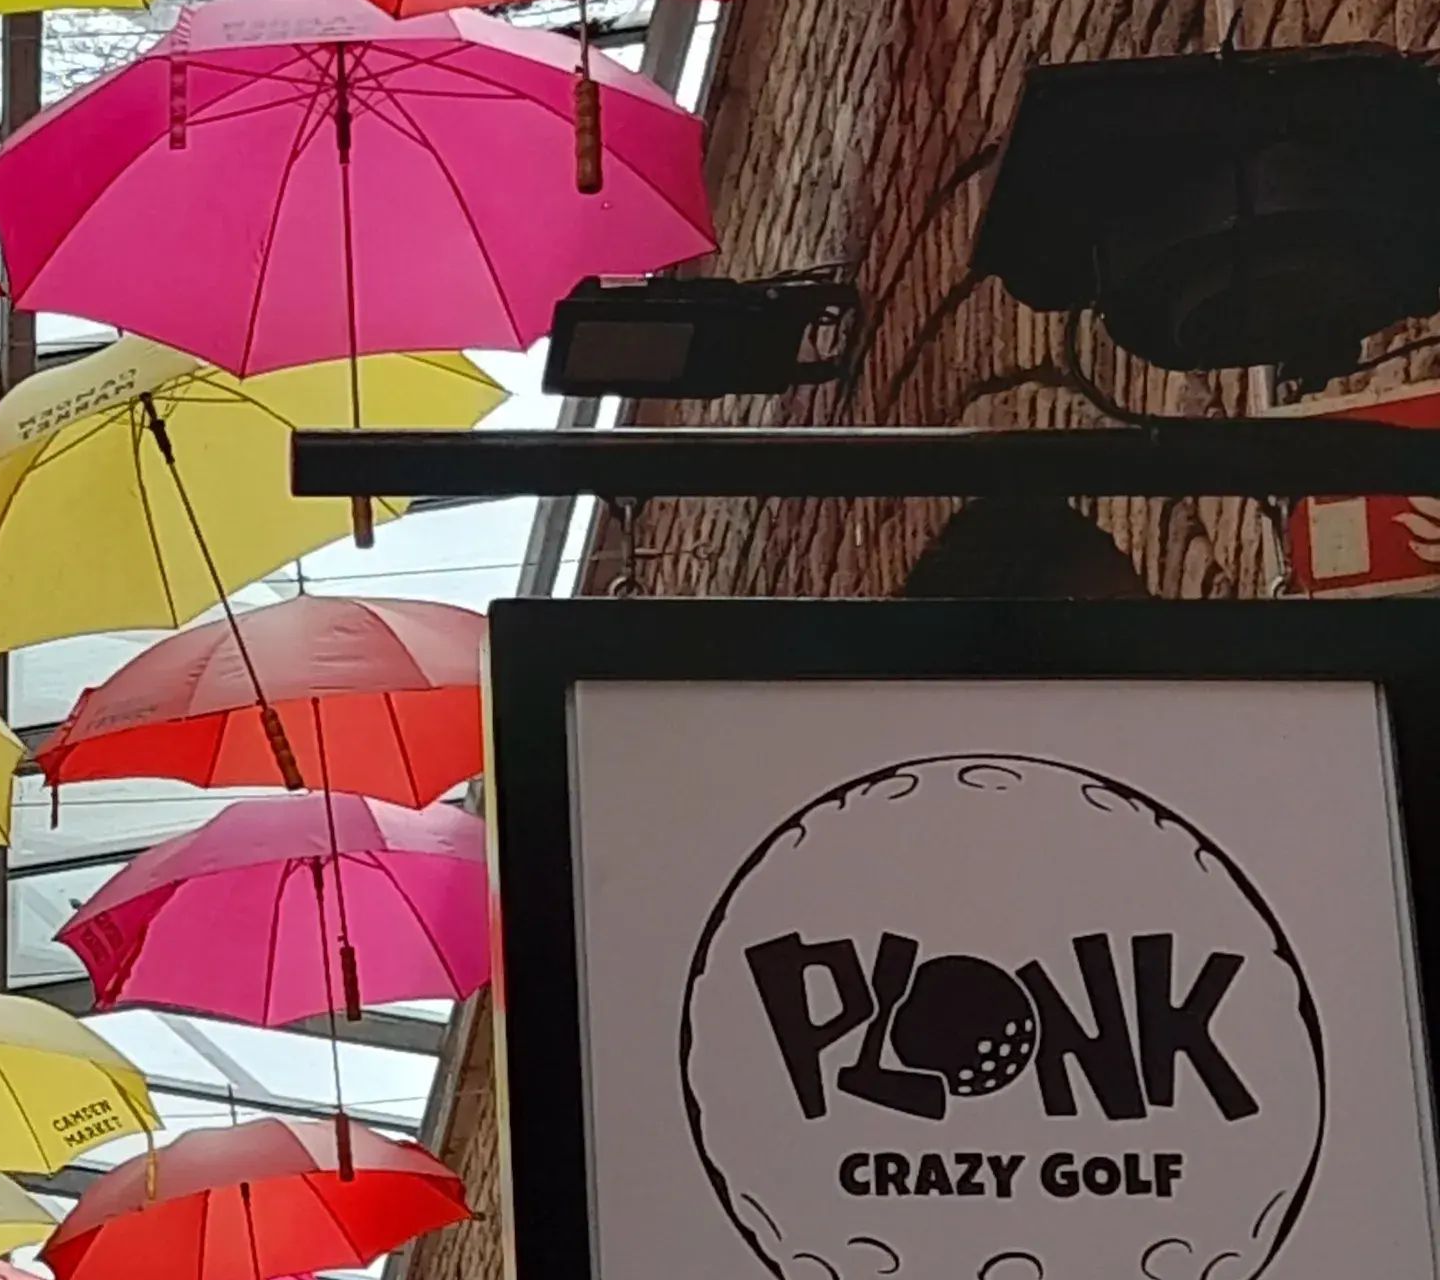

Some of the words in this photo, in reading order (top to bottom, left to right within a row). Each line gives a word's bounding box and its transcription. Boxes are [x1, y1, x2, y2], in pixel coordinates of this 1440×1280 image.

[745, 933, 1260, 1122] PLONK
[52, 1099, 113, 1132] CAMDEN
[62, 1115, 123, 1148] MARKET
[838, 1152, 1026, 1199] CRAZY
[1039, 1153, 1184, 1199] GOLF
